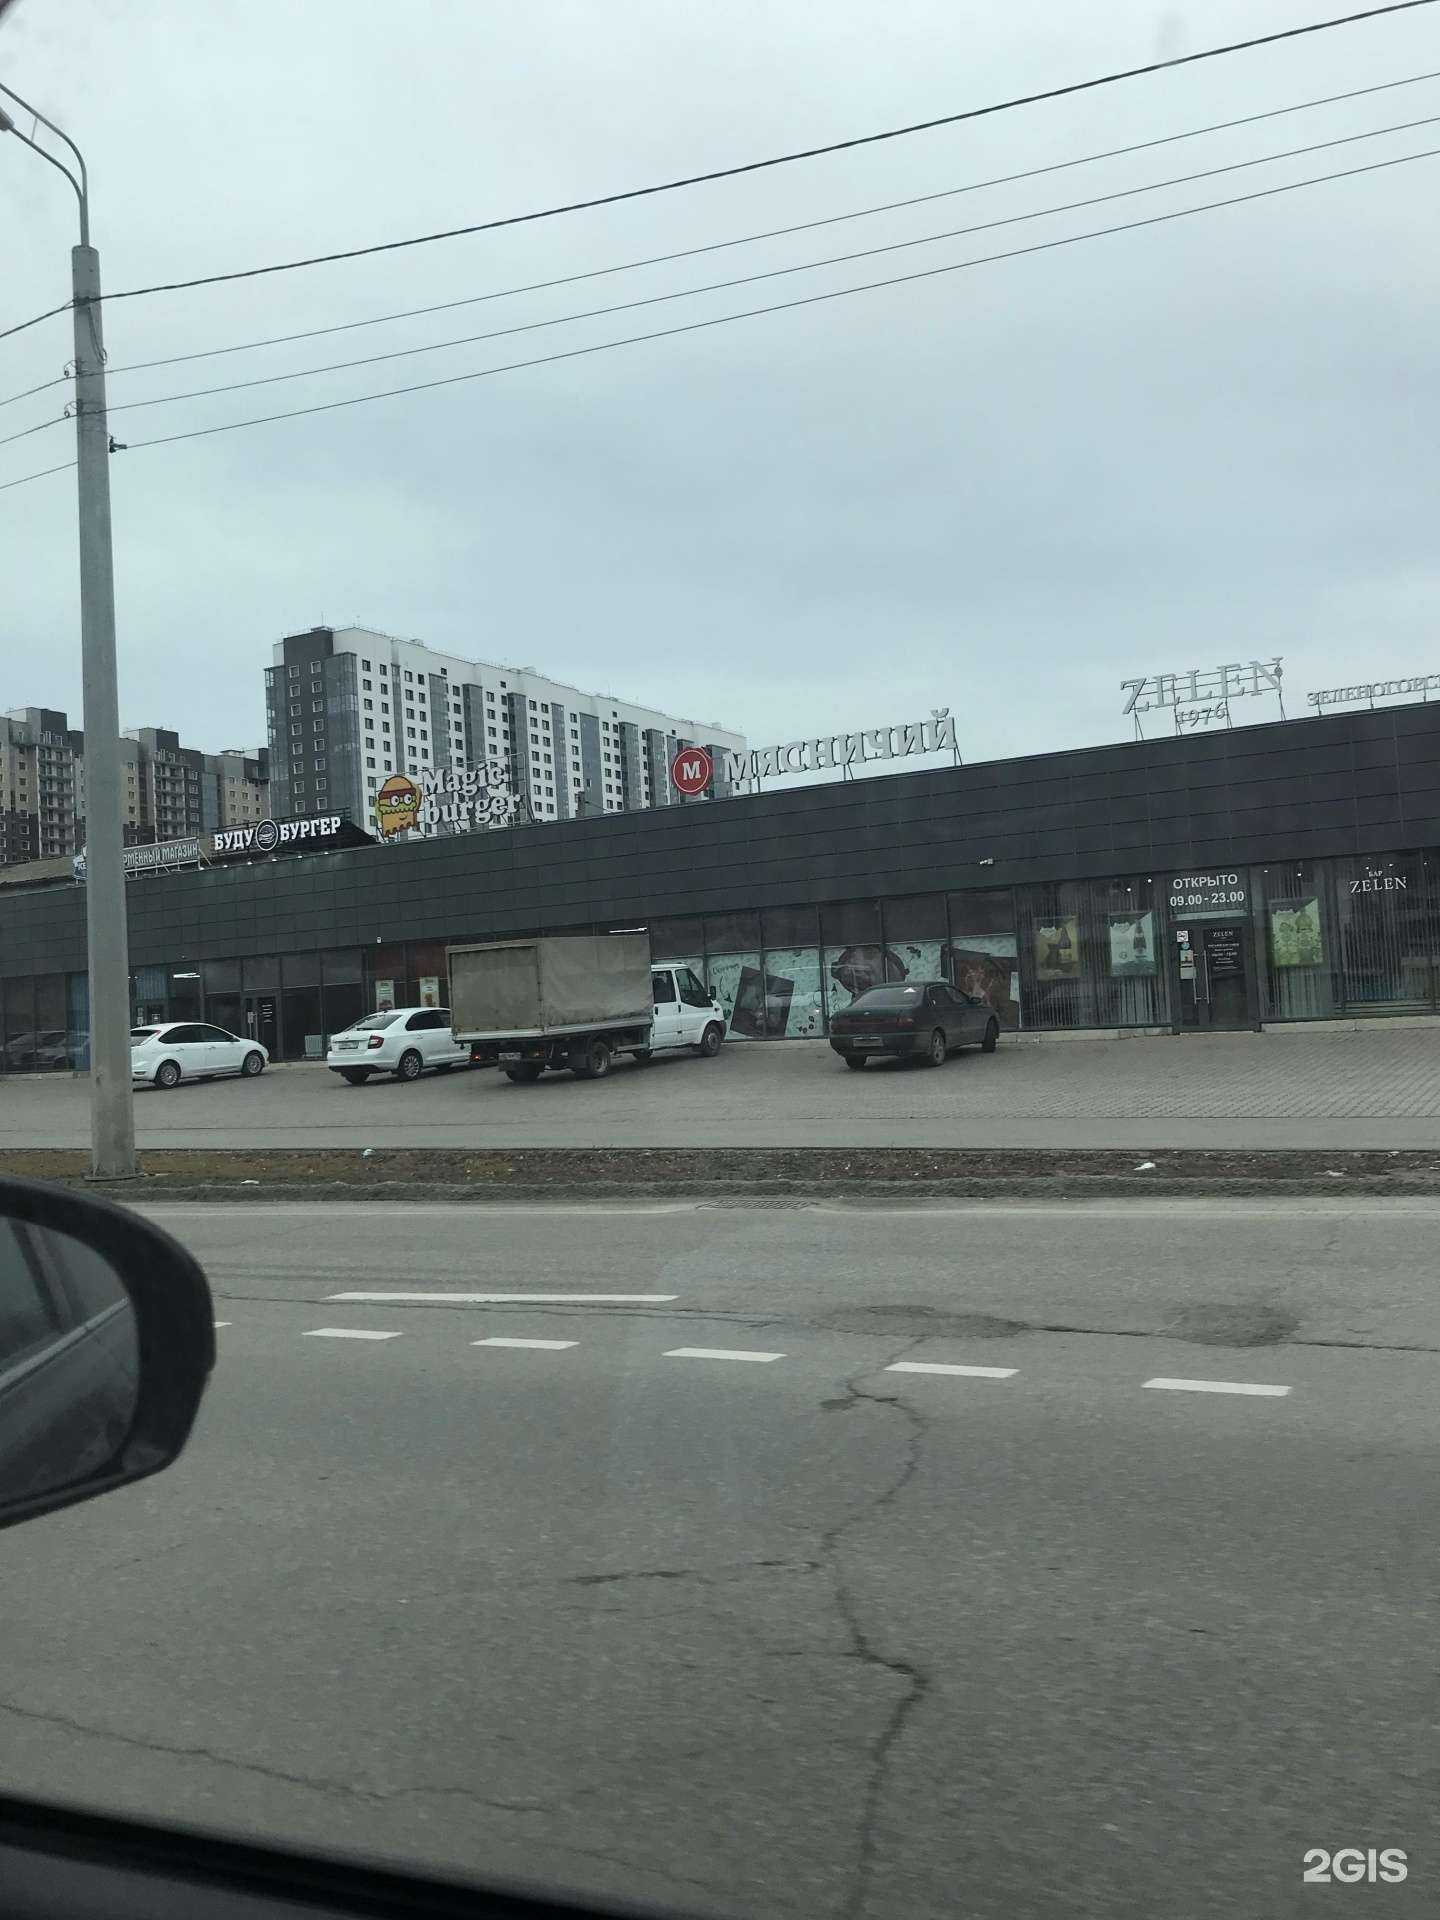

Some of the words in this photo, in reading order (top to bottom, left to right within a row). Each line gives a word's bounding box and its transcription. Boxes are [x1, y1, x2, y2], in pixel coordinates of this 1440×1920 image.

[1120, 656, 1284, 715] ZELEN
[1175, 701, 1226, 728] 1976
[723, 707, 957, 783] МЯСНИЧИЙ
[422, 762, 509, 796] Magic
[424, 794, 522, 824] burger
[214, 829, 254, 851] БУДУ
[280, 816, 341, 841] БУРГЕР
[123, 847, 161, 868] РМЕННЫЙ
[162, 842, 198, 861] МАГАЗИН
[1173, 874, 1238, 889] ОТКРЫТО
[1349, 876, 1407, 893] ZELEN
[1170, 894, 1202, 907] 09.00
[1211, 891, 1245, 904] 23.00
